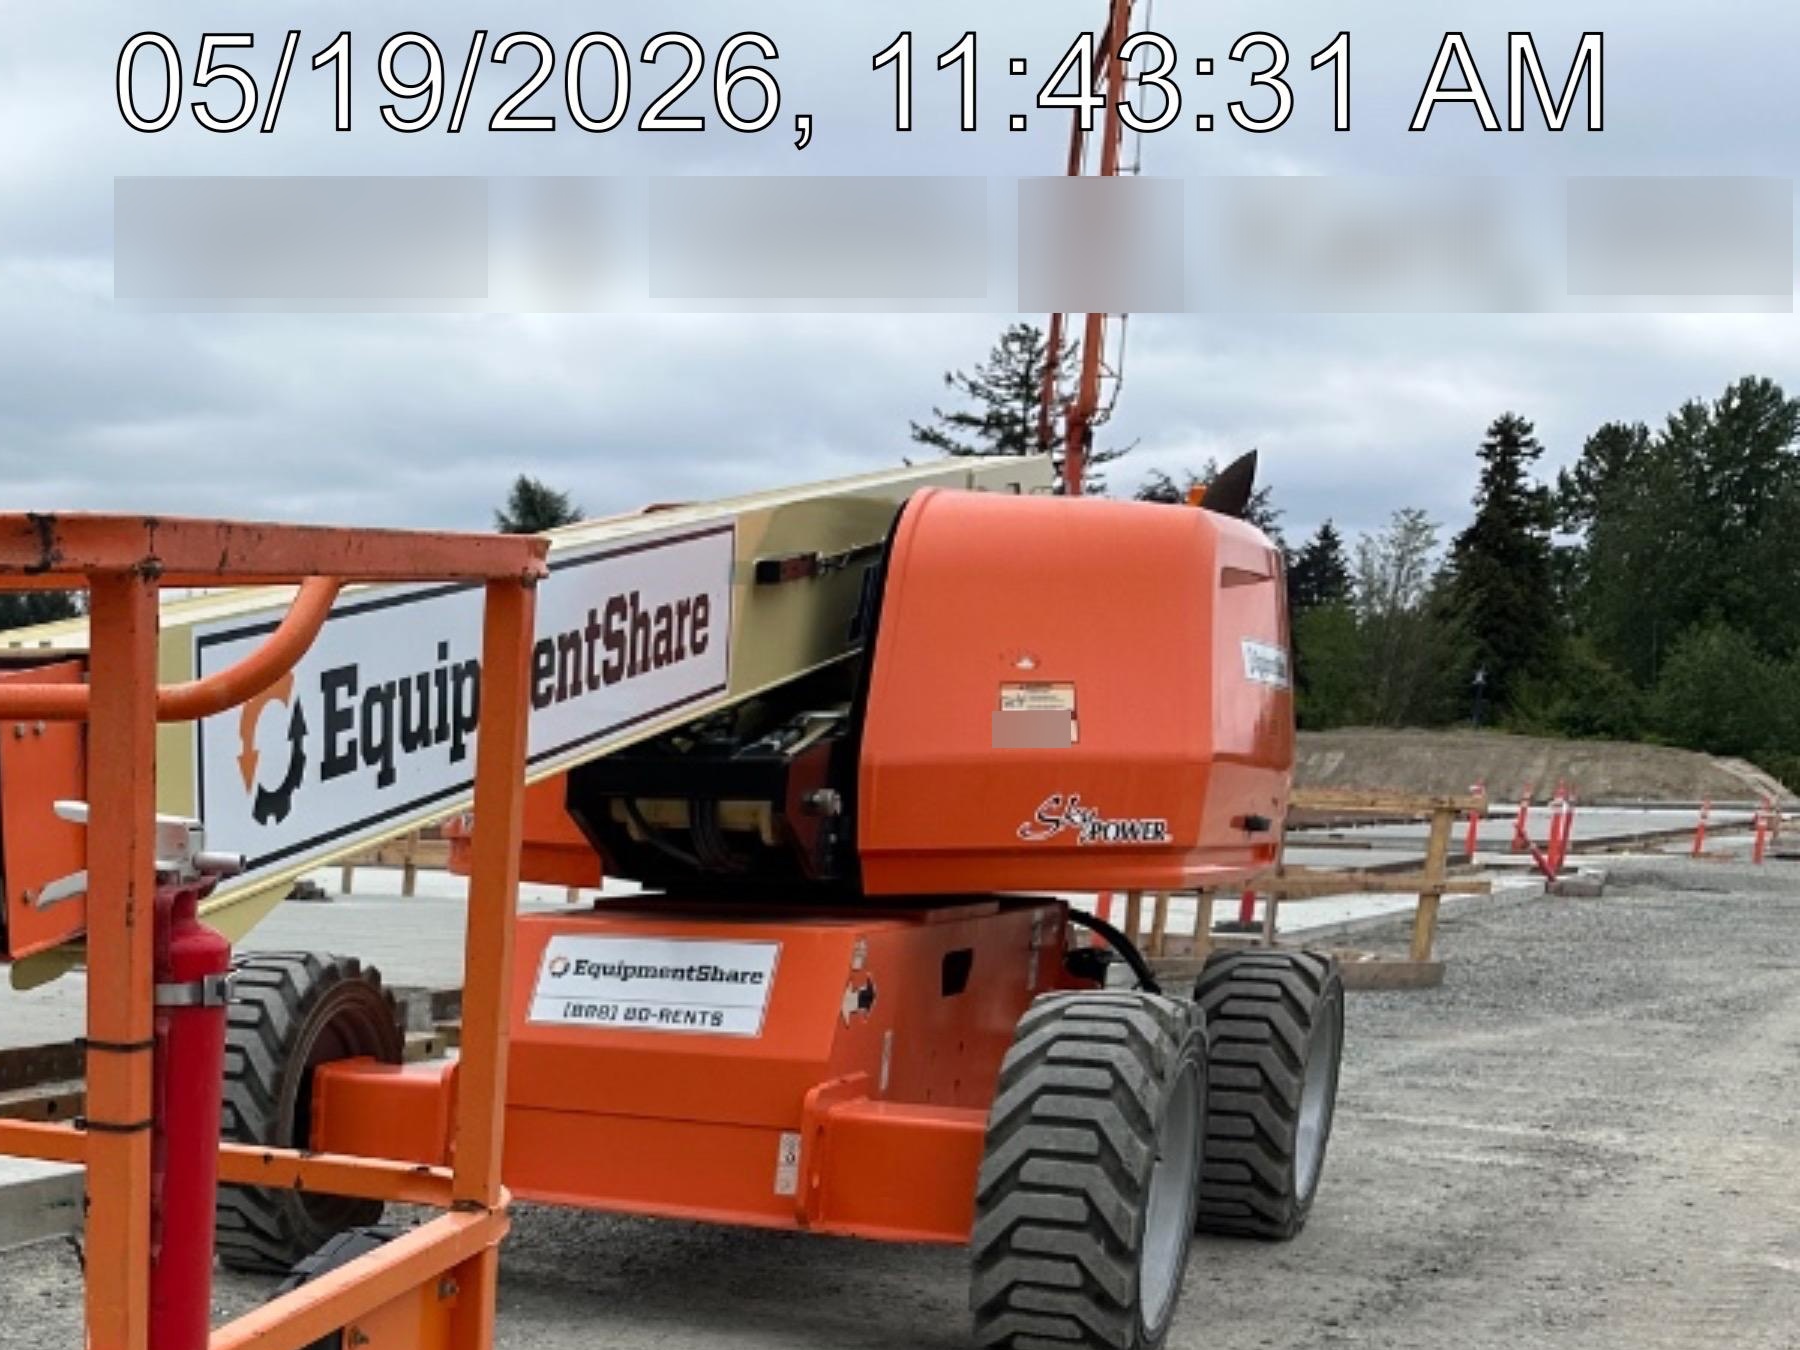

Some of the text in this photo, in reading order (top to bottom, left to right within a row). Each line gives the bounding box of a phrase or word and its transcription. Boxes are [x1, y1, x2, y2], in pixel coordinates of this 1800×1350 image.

[320, 591, 710, 789] EquipentShare
[1088, 820, 1167, 842] POWER
[573, 960, 764, 985] EquipmentShare
